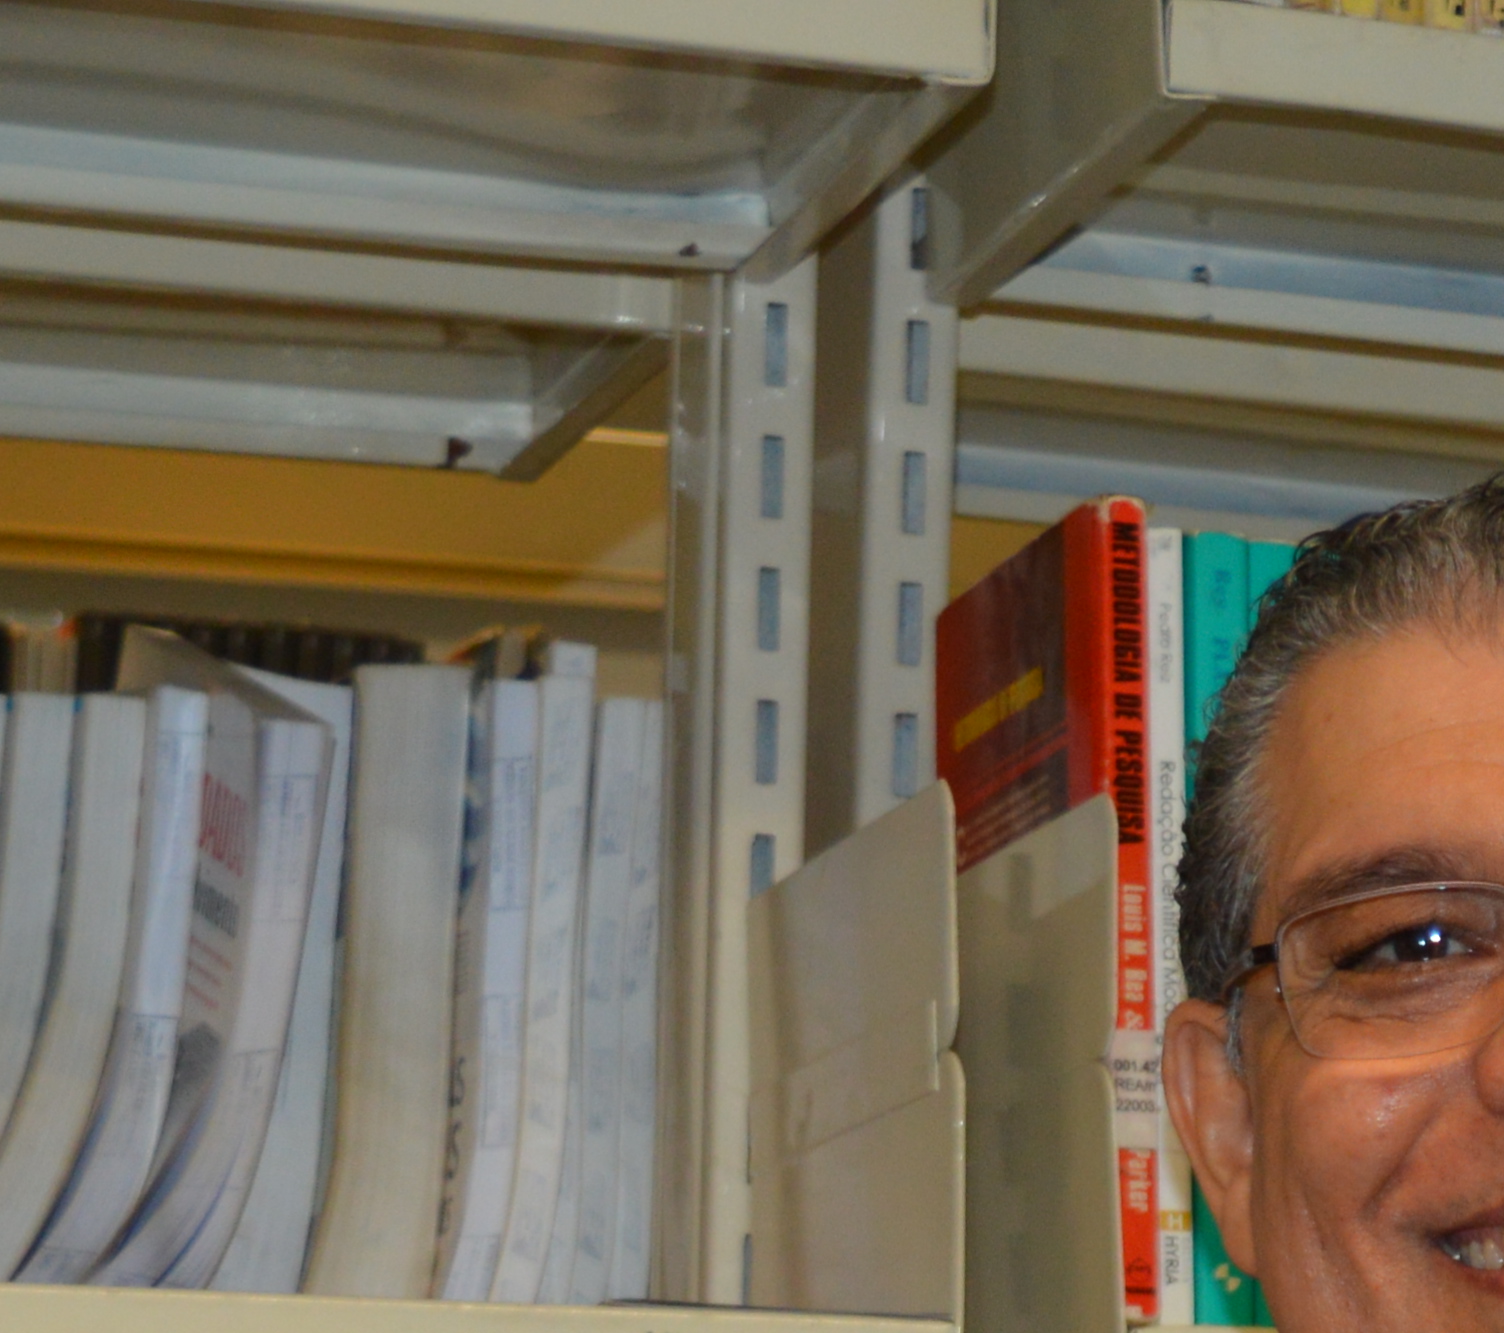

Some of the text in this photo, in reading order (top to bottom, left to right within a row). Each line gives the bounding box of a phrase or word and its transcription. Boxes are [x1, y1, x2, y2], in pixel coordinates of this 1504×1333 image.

[1112, 521, 1144, 845] METODOLOGIA DE PESQUISA
[1122, 883, 1146, 935] Louis
[1163, 1235, 1180, 1286] HYRIA
